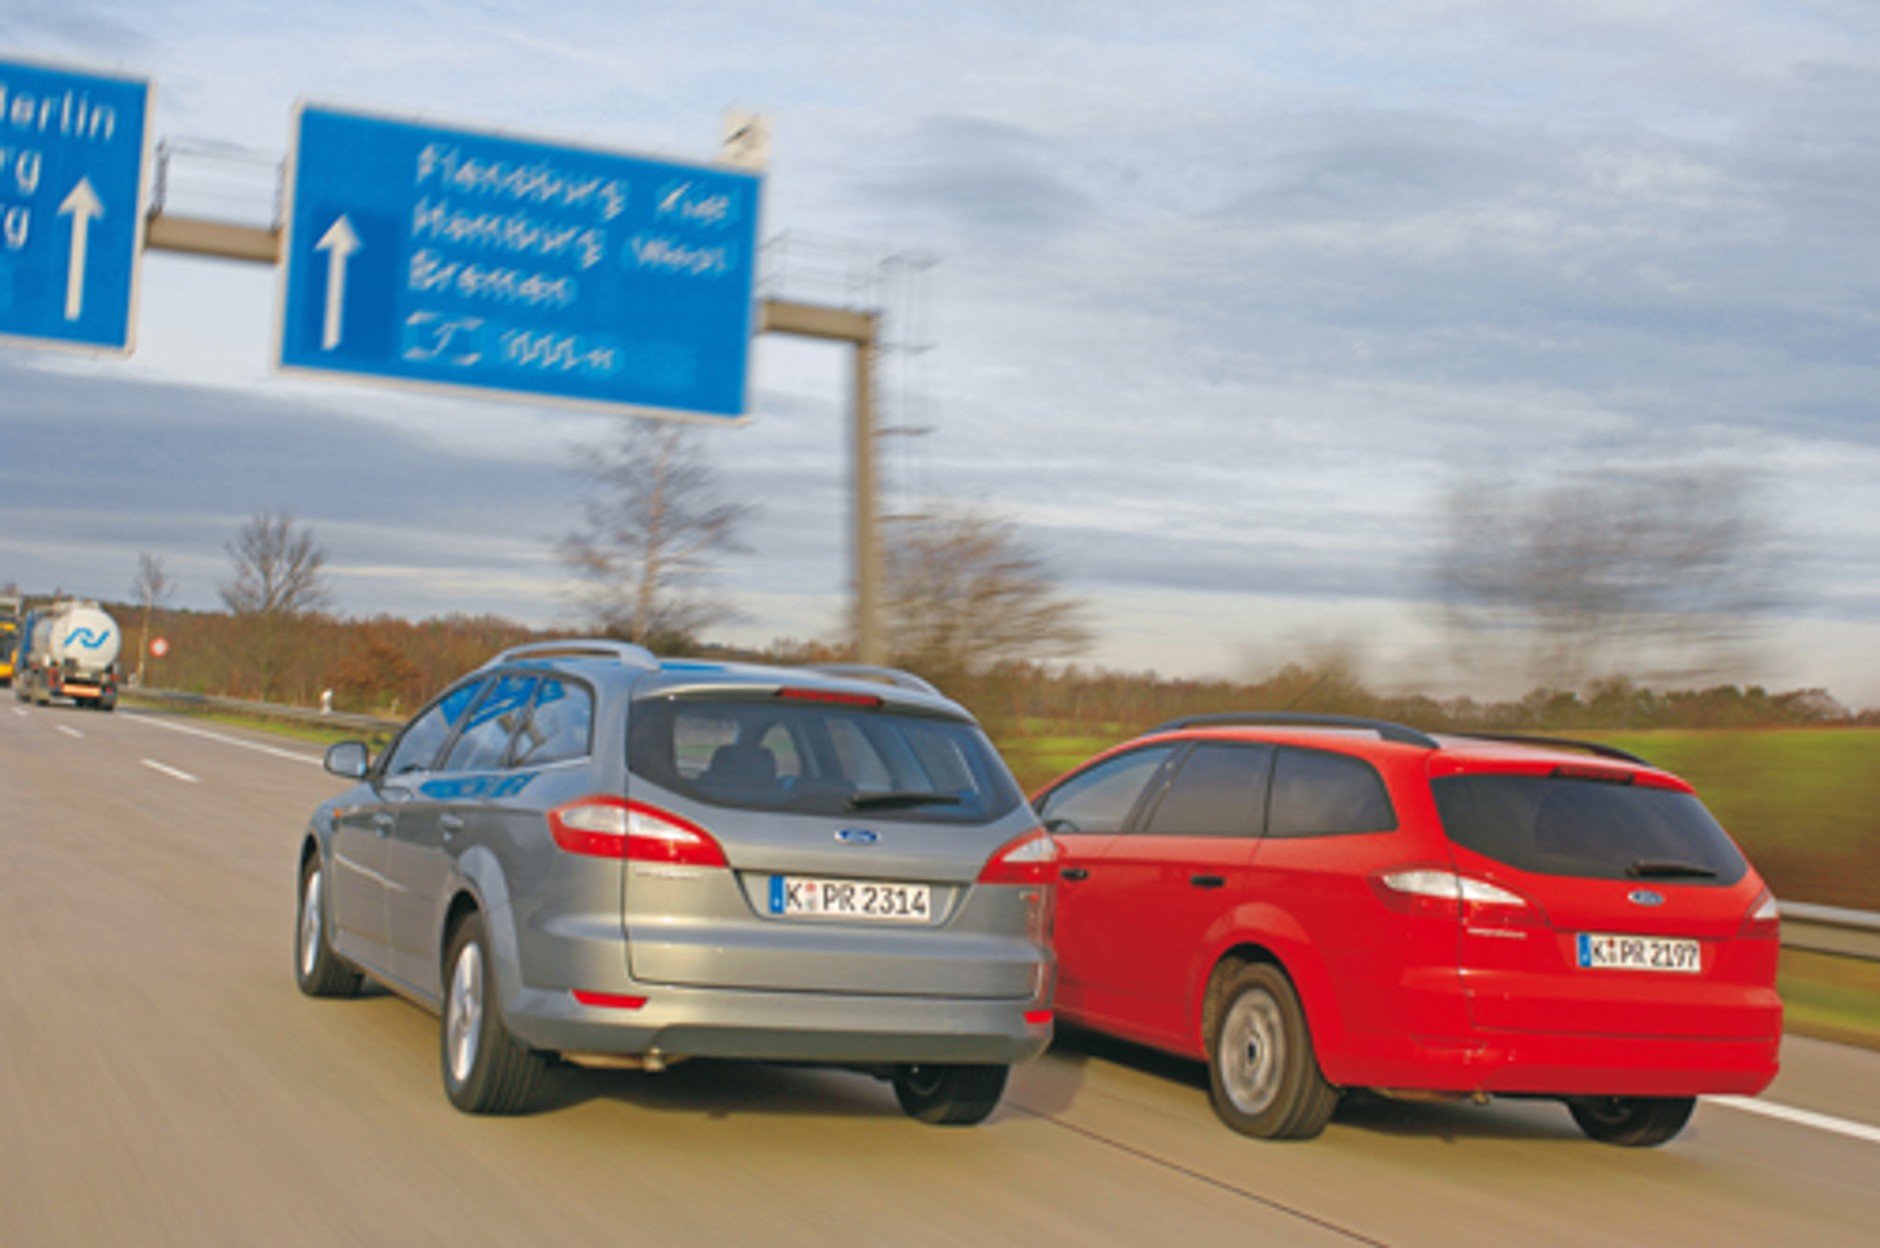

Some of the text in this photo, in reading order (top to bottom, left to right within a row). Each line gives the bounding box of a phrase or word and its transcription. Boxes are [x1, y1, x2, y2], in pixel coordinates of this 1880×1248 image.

[0, 84, 116, 141] erlin
[786, 883, 927, 915] K PR 2314
[1593, 939, 1698, 968] K PR 2197
